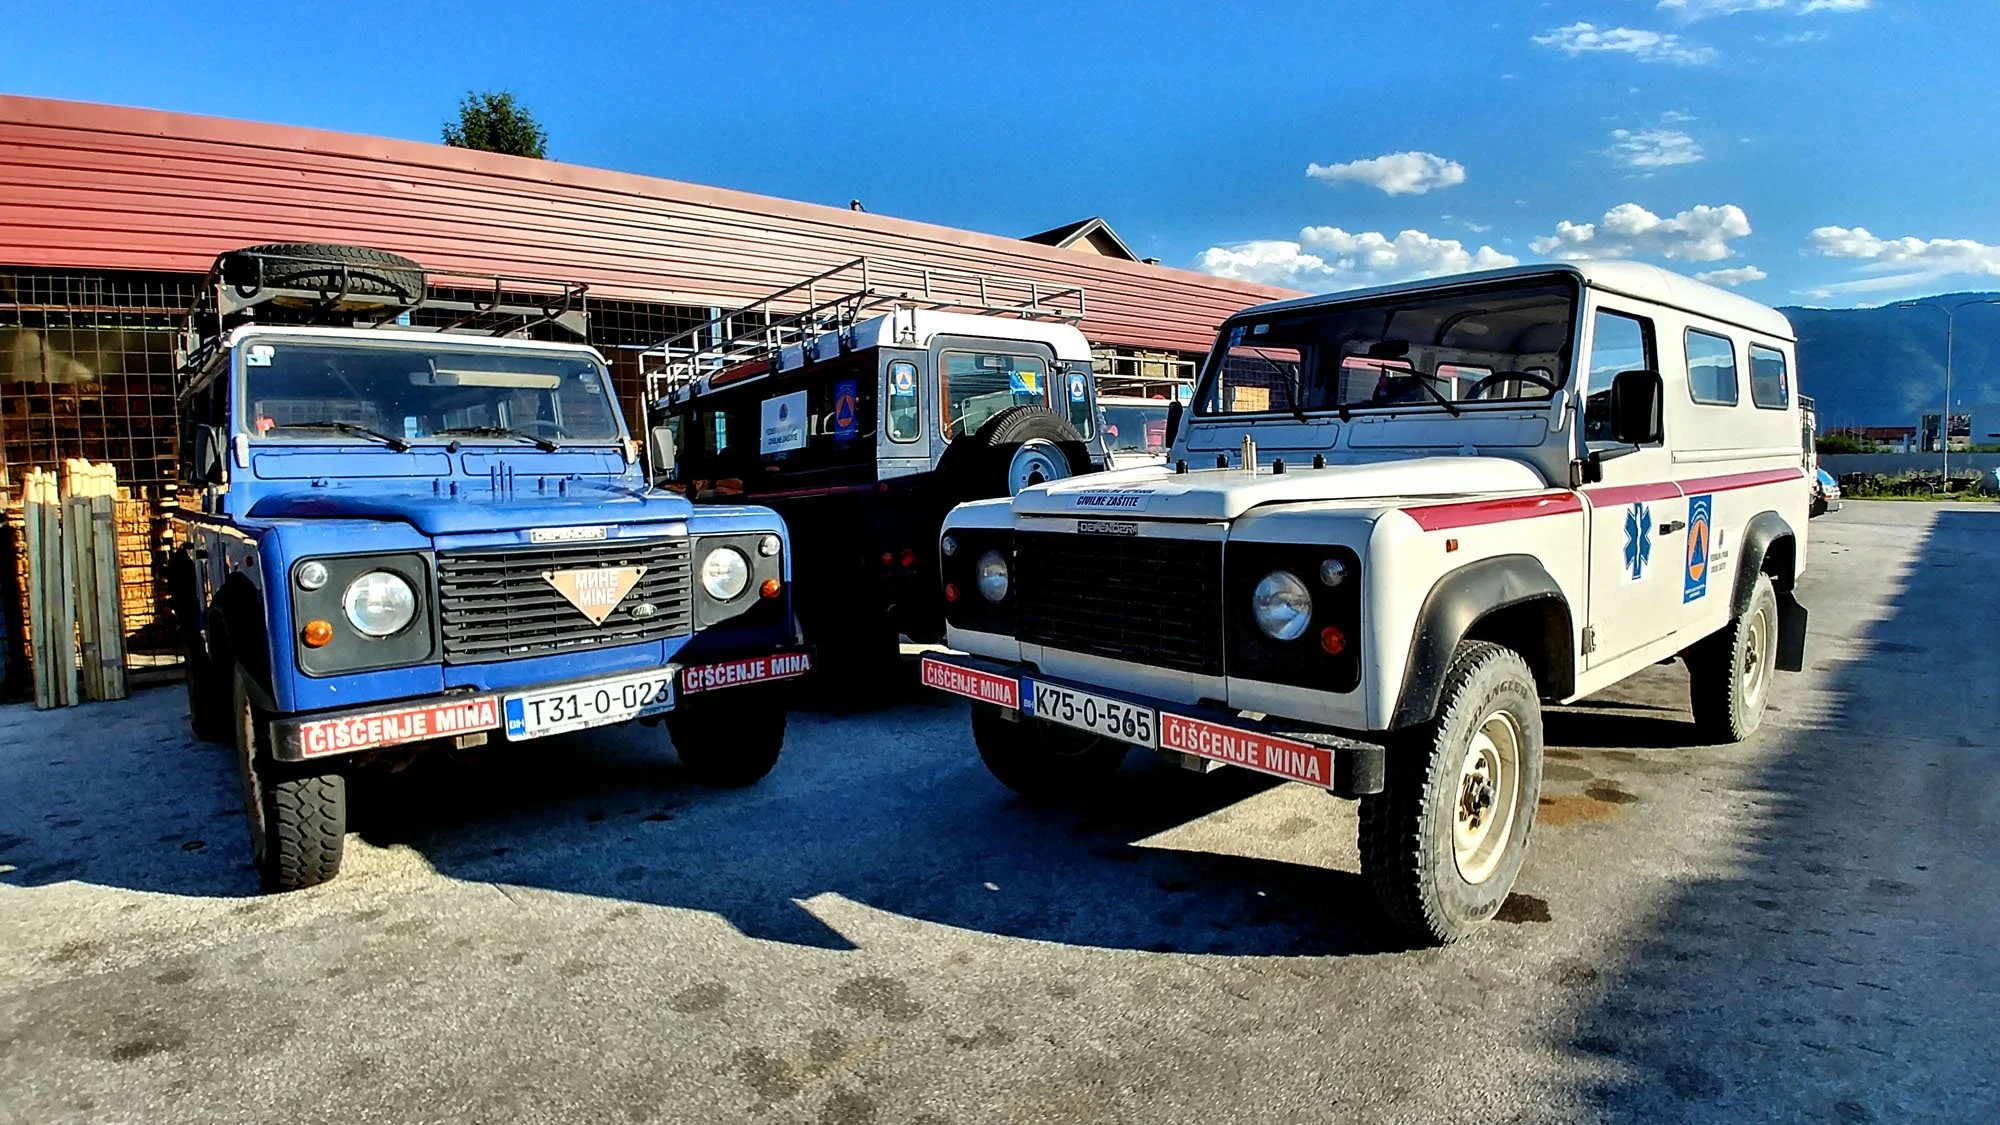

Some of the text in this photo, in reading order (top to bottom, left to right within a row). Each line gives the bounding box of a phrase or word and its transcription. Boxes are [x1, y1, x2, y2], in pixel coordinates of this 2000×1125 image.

[1106, 494, 1140, 507] ZAŠTITE
[579, 588, 617, 606] MINE
[687, 654, 810, 689] ČIŠĆENJE MINA
[927, 663, 1012, 704] ČIŠĆENJE MINA
[308, 702, 496, 752] ČIŠĆENJE MINA
[1169, 719, 1321, 781] ČIŠĆENJE MINA
